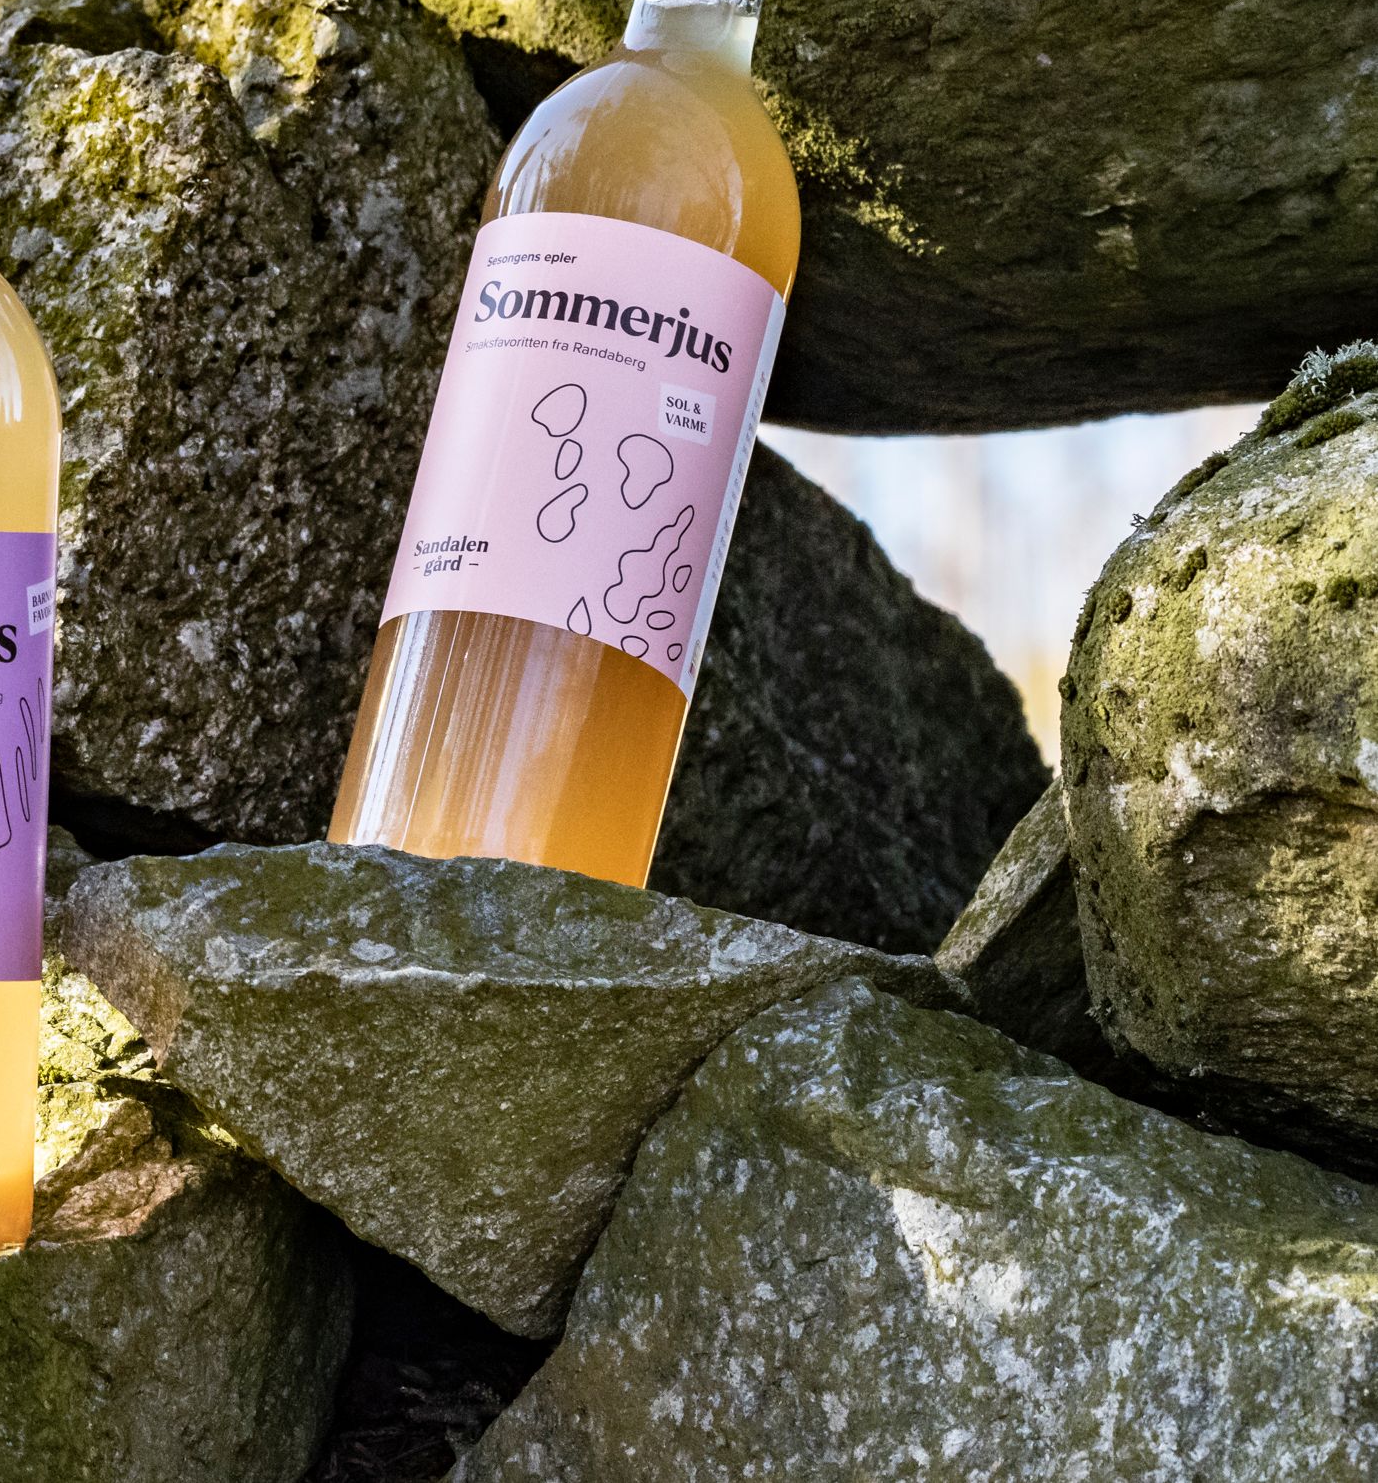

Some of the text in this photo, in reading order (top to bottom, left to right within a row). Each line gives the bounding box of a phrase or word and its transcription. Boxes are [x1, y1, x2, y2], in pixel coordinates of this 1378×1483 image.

[486, 252, 578, 267] Sesongens epler
[474, 280, 733, 374] Sommerjus
[465, 336, 647, 372] Smaksfavoritten fra Randaberg
[666, 396, 702, 415] SOL &
[665, 412, 708, 434] VARME
[413, 535, 490, 557] Sandalen
[423, 554, 462, 577] gård
